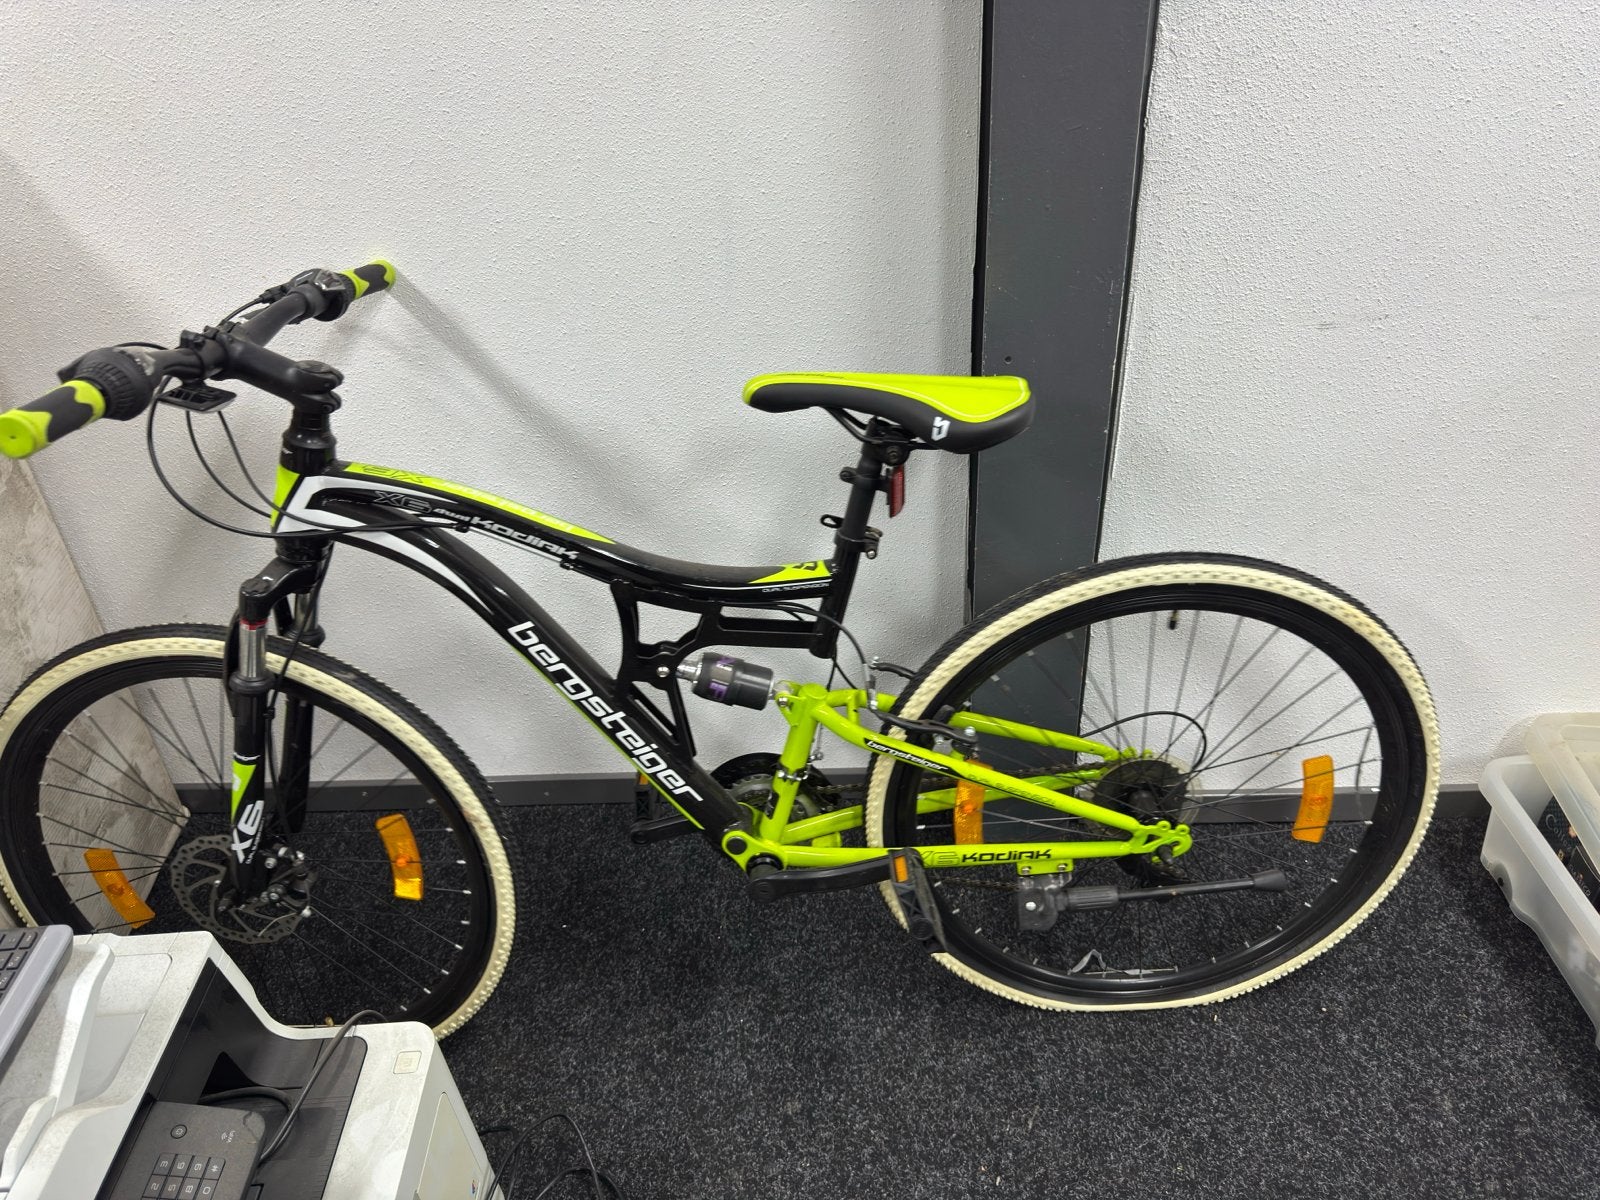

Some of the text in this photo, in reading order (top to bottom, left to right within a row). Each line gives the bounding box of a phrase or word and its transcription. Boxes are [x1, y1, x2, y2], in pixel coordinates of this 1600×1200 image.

[507, 620, 704, 802] bergsteiger
[867, 741, 949, 770] bergsteiger
[177, 1161, 185, 1169] 6
[194, 1162, 202, 1171] 9
[151, 1183, 160, 1191] 2
[168, 1184, 176, 1192] 5
[185, 1185, 194, 1193] 8
